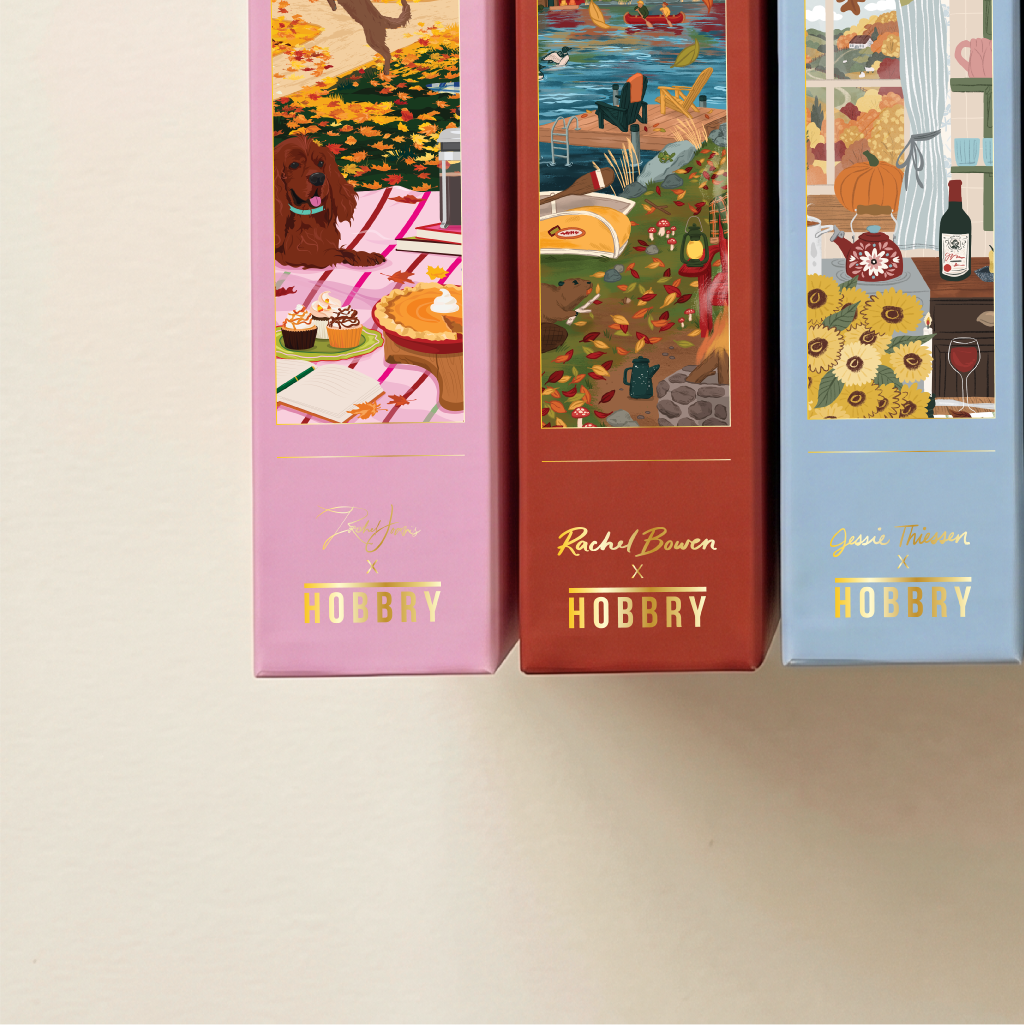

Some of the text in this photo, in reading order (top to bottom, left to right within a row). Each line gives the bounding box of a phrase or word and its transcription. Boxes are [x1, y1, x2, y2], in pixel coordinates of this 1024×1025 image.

[556, 526, 718, 558] Rachel Bowen
[829, 524, 971, 558] Jessie Thiessen
[304, 591, 442, 624] HOBBRY
[569, 596, 707, 630] HOBBRY
[835, 586, 972, 619] HOBBRY
